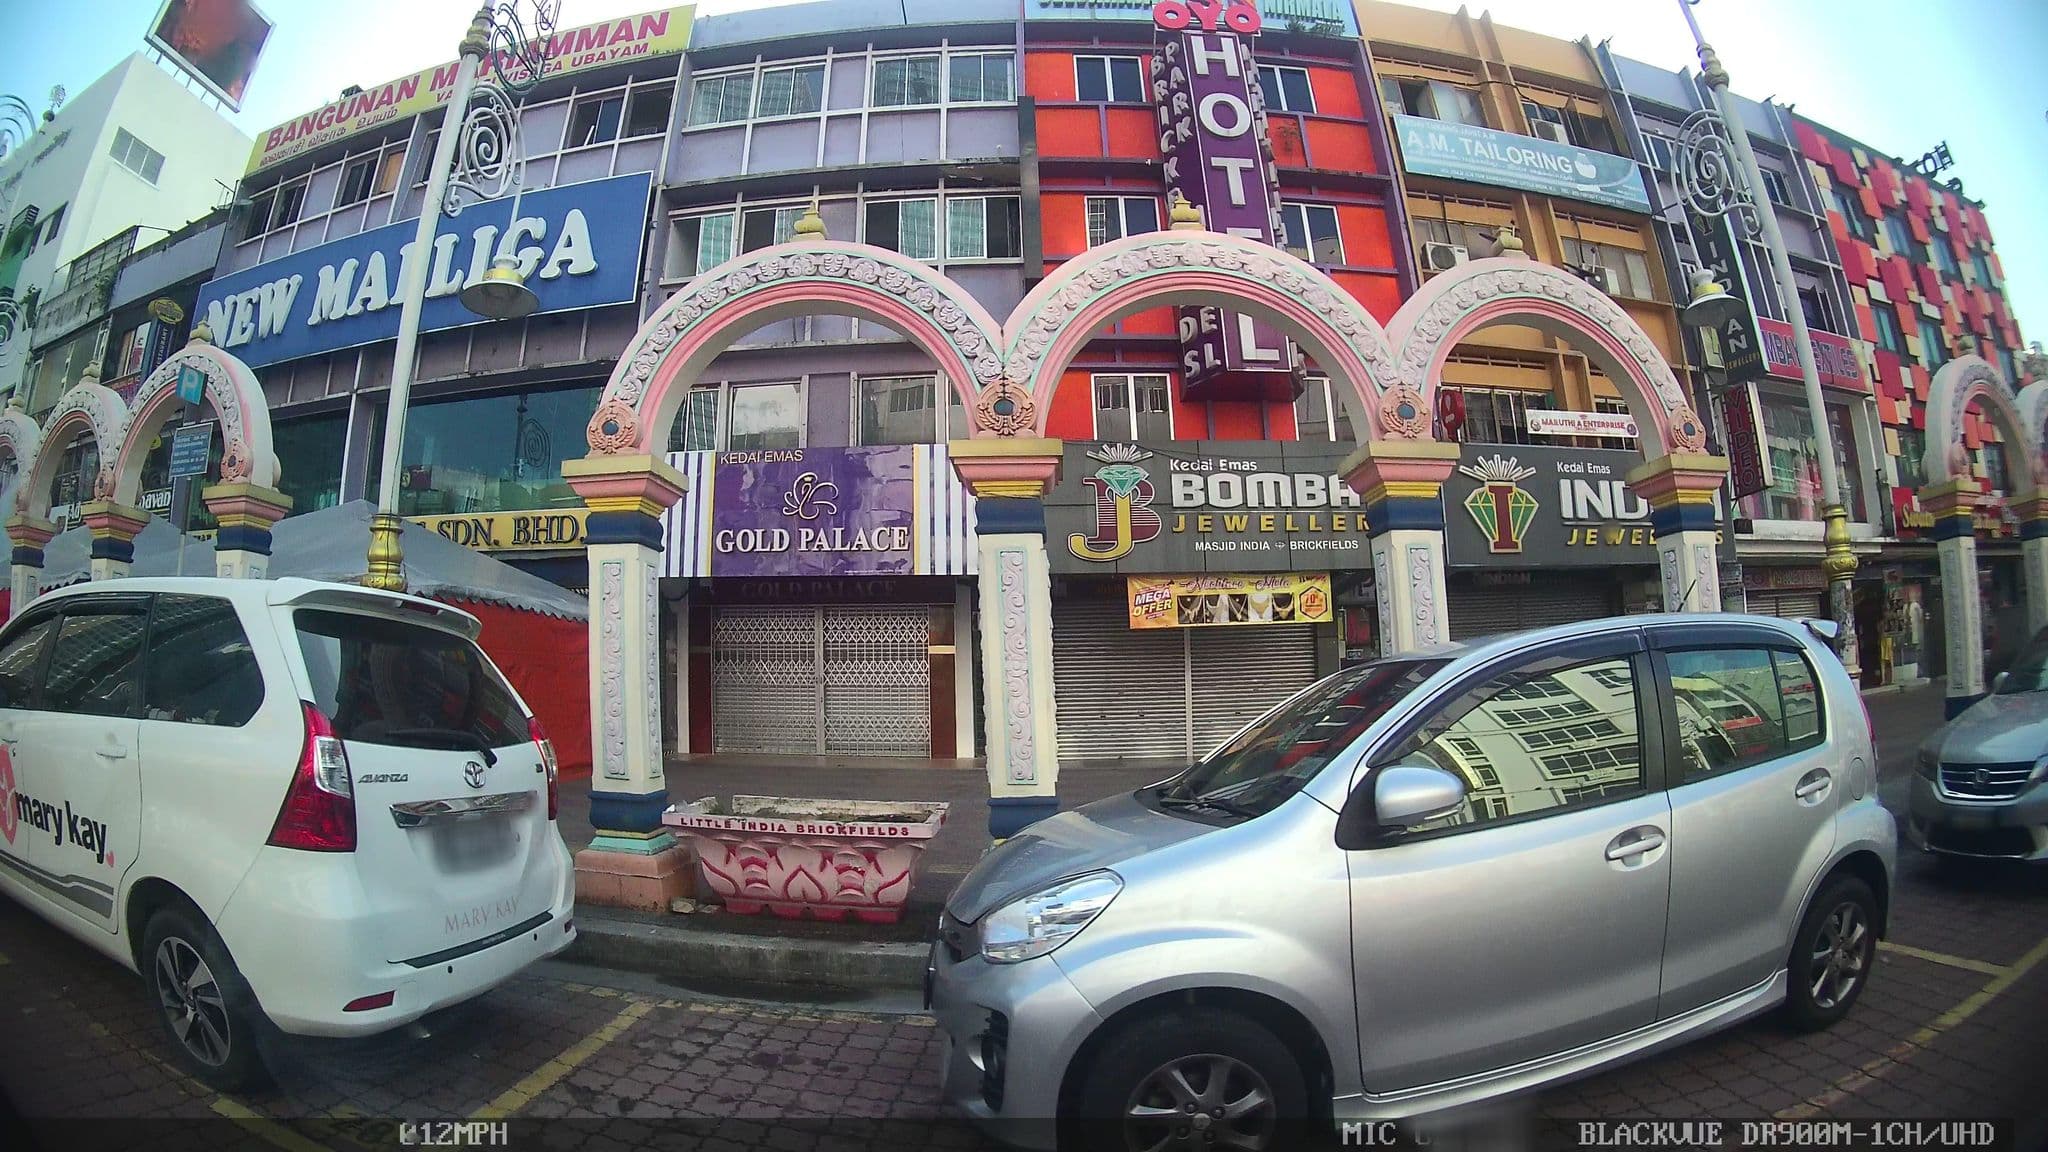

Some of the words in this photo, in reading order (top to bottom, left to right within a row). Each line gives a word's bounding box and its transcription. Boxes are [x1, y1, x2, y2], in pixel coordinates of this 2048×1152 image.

[1152, 0, 1262, 33] OYO
[571, 43, 649, 67] UBAYAM
[1165, 42, 1193, 144] PARK
[265, 75, 420, 152] BANGUNAN
[1458, 137, 1573, 174] TAILORING
[1190, 35, 1280, 361] HOTL
[208, 274, 302, 348] NEW
[1708, 241, 1749, 354] INDAN
[1726, 389, 1755, 486] VIDEO
[720, 452, 760, 465] KEDAI
[764, 449, 803, 463] EMAS
[1170, 459, 1213, 471] Kedai
[1219, 459, 1257, 471] Emas
[1557, 462, 1583, 473] Kedai
[1588, 462, 1610, 474] Emas
[1171, 473, 1361, 508] BOMBA
[437, 517, 500, 546] SDN.
[512, 514, 585, 545] BHD.
[715, 529, 791, 553] GOLD
[798, 526, 910, 551] PALACE
[1172, 514, 1370, 533] JEWELLER
[1195, 541, 1237, 551] MASJID
[1240, 540, 1271, 551] INDIA
[1289, 540, 1359, 550] BRICKFIELDS
[1133, 599, 1172, 616] OFFER
[1135, 589, 1171, 606] MEGA
[15, 790, 63, 846] mary
[65, 800, 107, 864] kay
[680, 817, 732, 829] LITTLE
[741, 821, 787, 833] INDIA
[796, 824, 910, 836] BRICKFIELDS
[445, 906, 491, 934] MARY
[496, 895, 520, 919] KAY
